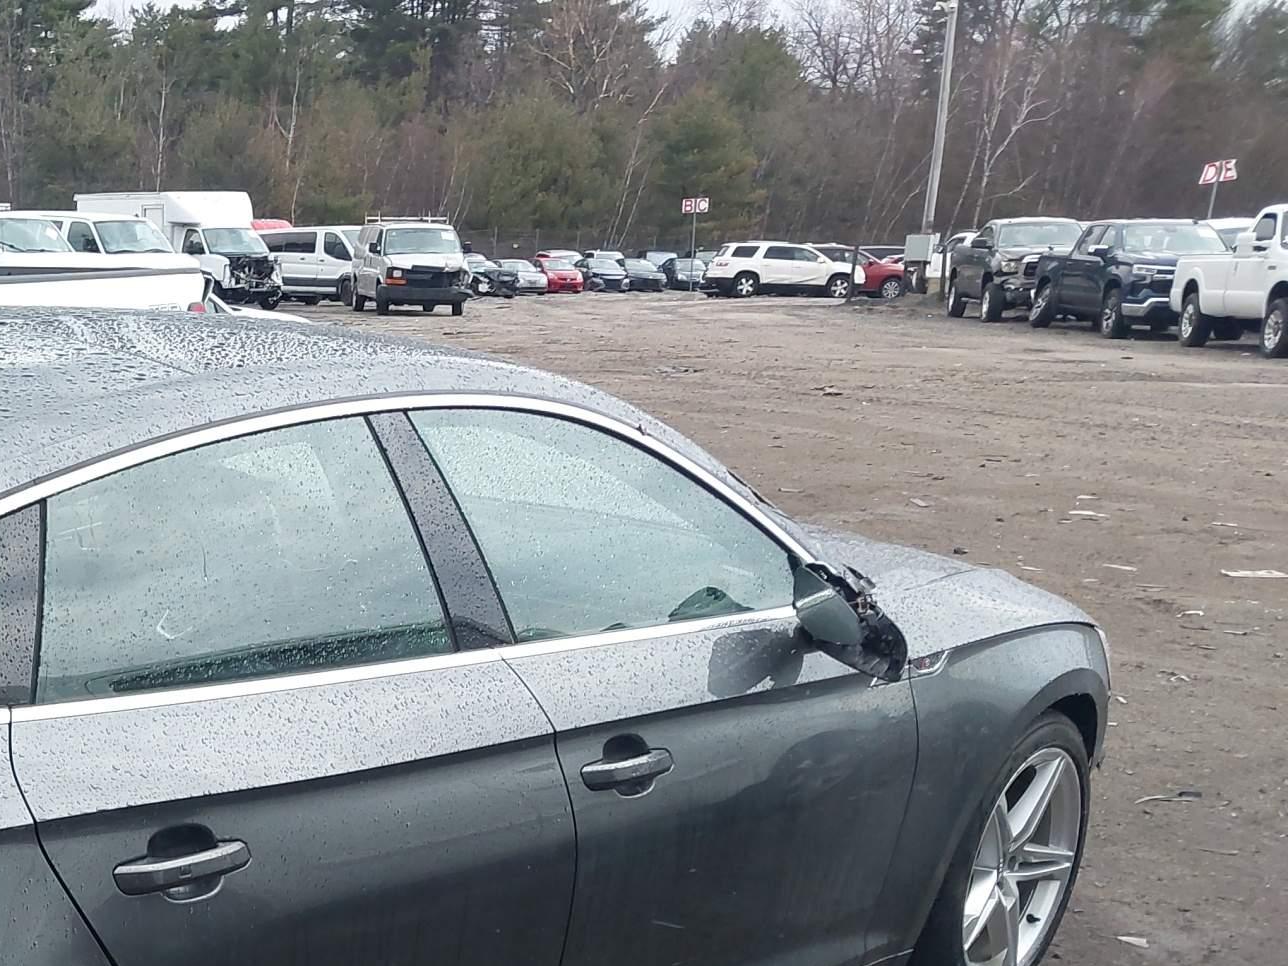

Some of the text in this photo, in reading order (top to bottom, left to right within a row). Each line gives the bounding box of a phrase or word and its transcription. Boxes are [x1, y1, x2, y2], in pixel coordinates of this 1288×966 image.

[1202, 160, 1235, 182] D E
[684, 199, 708, 212] B C
